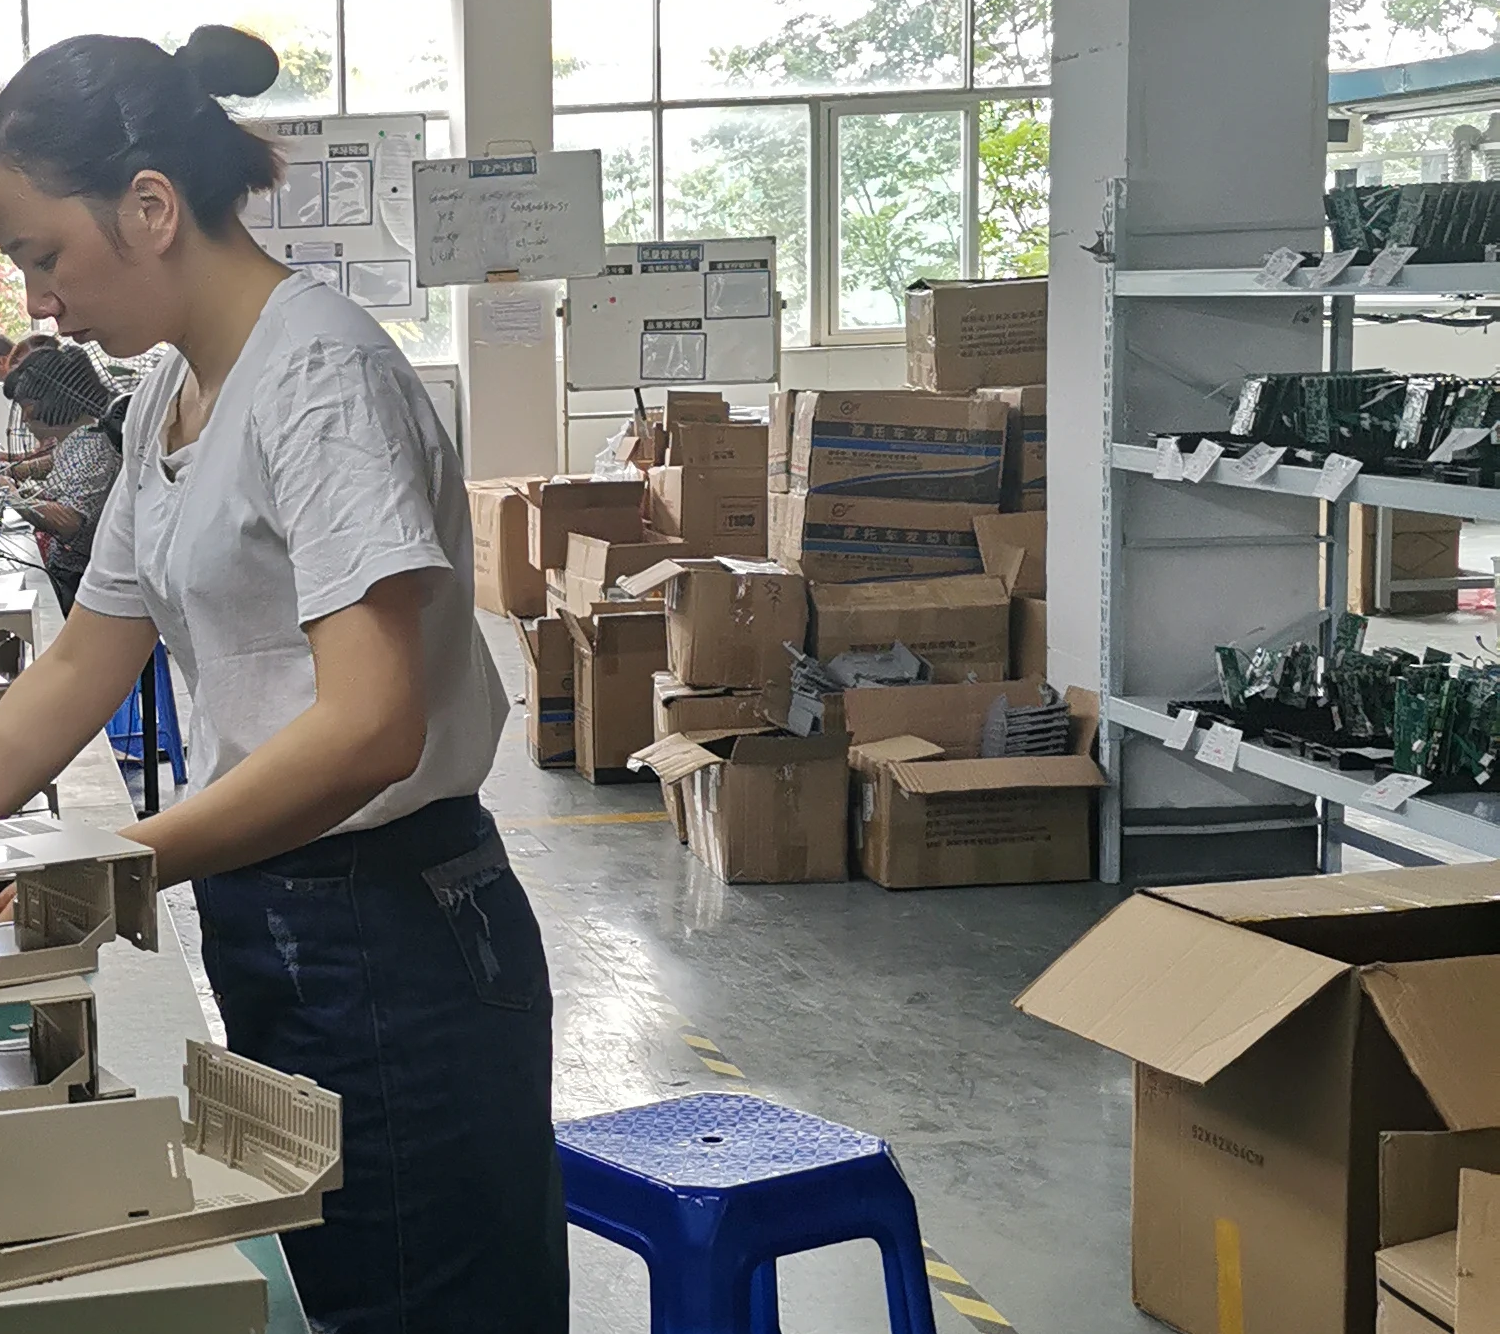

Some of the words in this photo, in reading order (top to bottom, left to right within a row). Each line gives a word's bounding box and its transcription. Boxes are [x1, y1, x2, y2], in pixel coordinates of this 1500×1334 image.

[851, 424, 970, 444] 摩托车发动机
